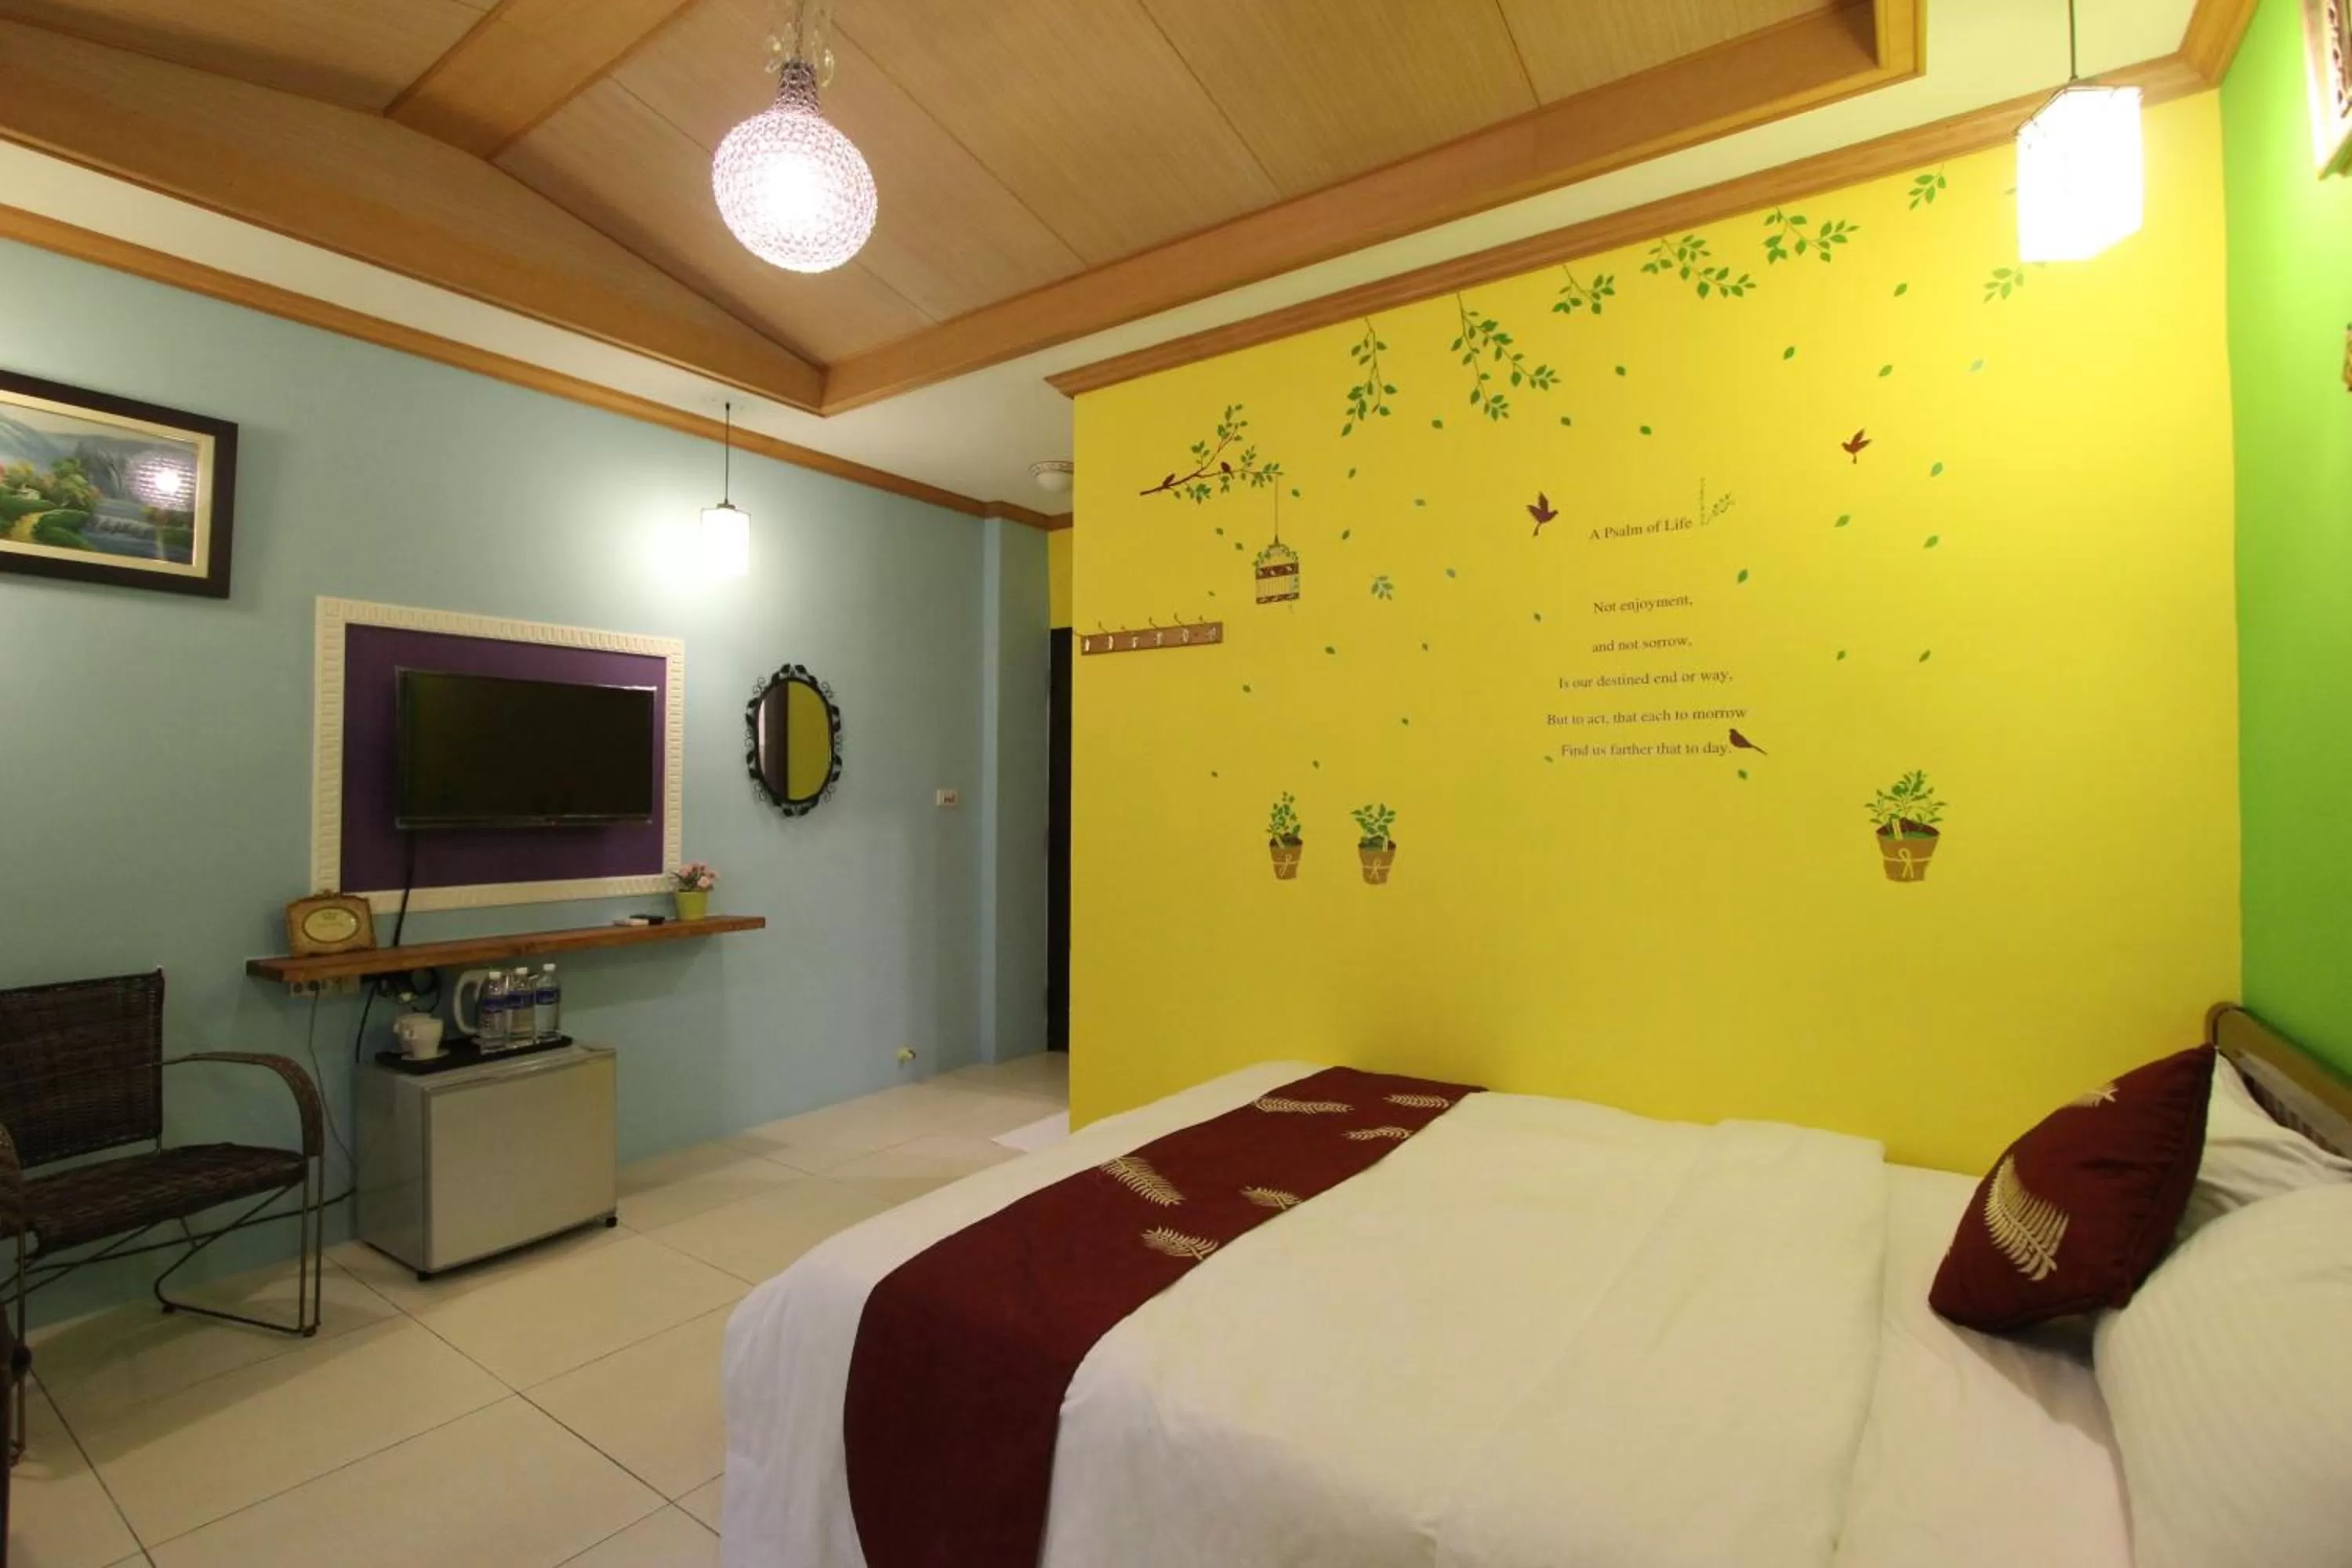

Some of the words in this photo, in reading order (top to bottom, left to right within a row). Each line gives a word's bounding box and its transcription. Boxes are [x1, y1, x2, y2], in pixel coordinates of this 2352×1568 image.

[1589, 528, 1600, 540] A
[1604, 523, 1643, 540] Psalm
[1646, 520, 1663, 534] of
[1664, 517, 1693, 532] Life
[1593, 601, 1617, 614] Not
[1592, 639, 1615, 653] and
[1617, 639, 1639, 652] not
[1571, 678, 1594, 688] our
[1596, 673, 1650, 687] destined
[1653, 670, 1679, 684] end
[1681, 672, 1697, 683] or
[1546, 713, 1569, 726] But
[1572, 714, 1584, 726] to
[1611, 711, 1638, 724] that
[1640, 709, 1671, 723] each
[1675, 710, 1689, 721] to
[1692, 709, 1748, 720] morrow
[1561, 744, 1589, 758] Find
[1592, 746, 1606, 757] us
[1610, 742, 1653, 756] farther
[1656, 742, 1682, 755] that
[1685, 744, 1699, 754] to
